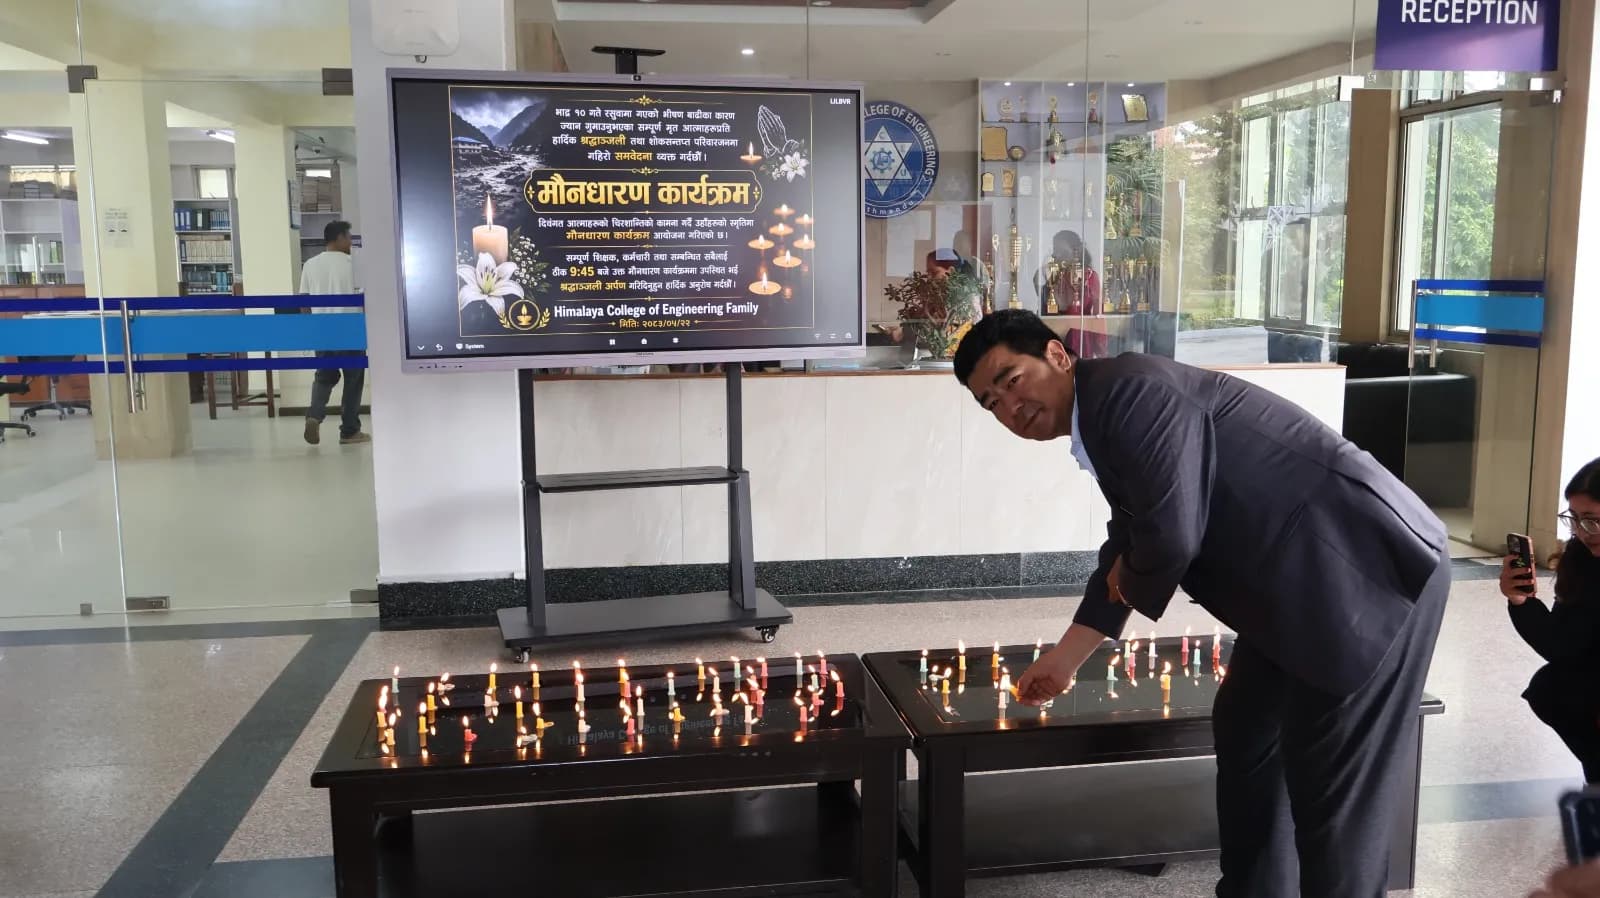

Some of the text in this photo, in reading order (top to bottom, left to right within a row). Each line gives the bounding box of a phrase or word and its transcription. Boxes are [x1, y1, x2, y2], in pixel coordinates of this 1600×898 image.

[1401, 0, 1537, 24] RECEPTION
[556, 108, 570, 117] भाद्र
[589, 107, 601, 117] गते
[604, 110, 632, 120] रसुवामा
[636, 108, 658, 118] गएको
[663, 109, 683, 119] भीषण
[715, 112, 735, 120] कारण
[560, 122, 581, 130] ज्यान
[585, 123, 634, 133] गुमाउनुभएका
[637, 121, 661, 134] सम्पूर्ण
[666, 125, 678, 134] मृत
[552, 134, 576, 145] हार्दिक
[630, 137, 645, 145] तथा
[649, 136, 690, 146] शोकसन्तप्त
[892, 106, 906, 120] OF
[905, 112, 936, 178] ENGINEERING
[588, 150, 610, 161] गहिरो
[614, 150, 652, 161] समवेदना
[537, 174, 750, 205] मौनधारण कार्यक्रम
[566, 230, 610, 240] मौनधारण
[613, 229, 650, 240] कार्यक्रम
[654, 230, 685, 239] आयोजना
[688, 230, 714, 239] गरिएको
[566, 252, 589, 264] सम्पूर्ण
[622, 252, 650, 262] कर्मचारी
[704, 251, 728, 261] सबैलाई
[552, 267, 568, 276] ठीक
[570, 267, 595, 276] 9:45
[597, 266, 608, 276] बजे
[612, 268, 625, 276] उक्त
[728, 265, 738, 275] भई
[605, 280, 626, 290] अर्पण
[666, 280, 687, 290] हार्दिक
[554, 302, 759, 319] Himalaya College of Engineering Family
[642, 319, 690, 328] २०८३/०५/२२
